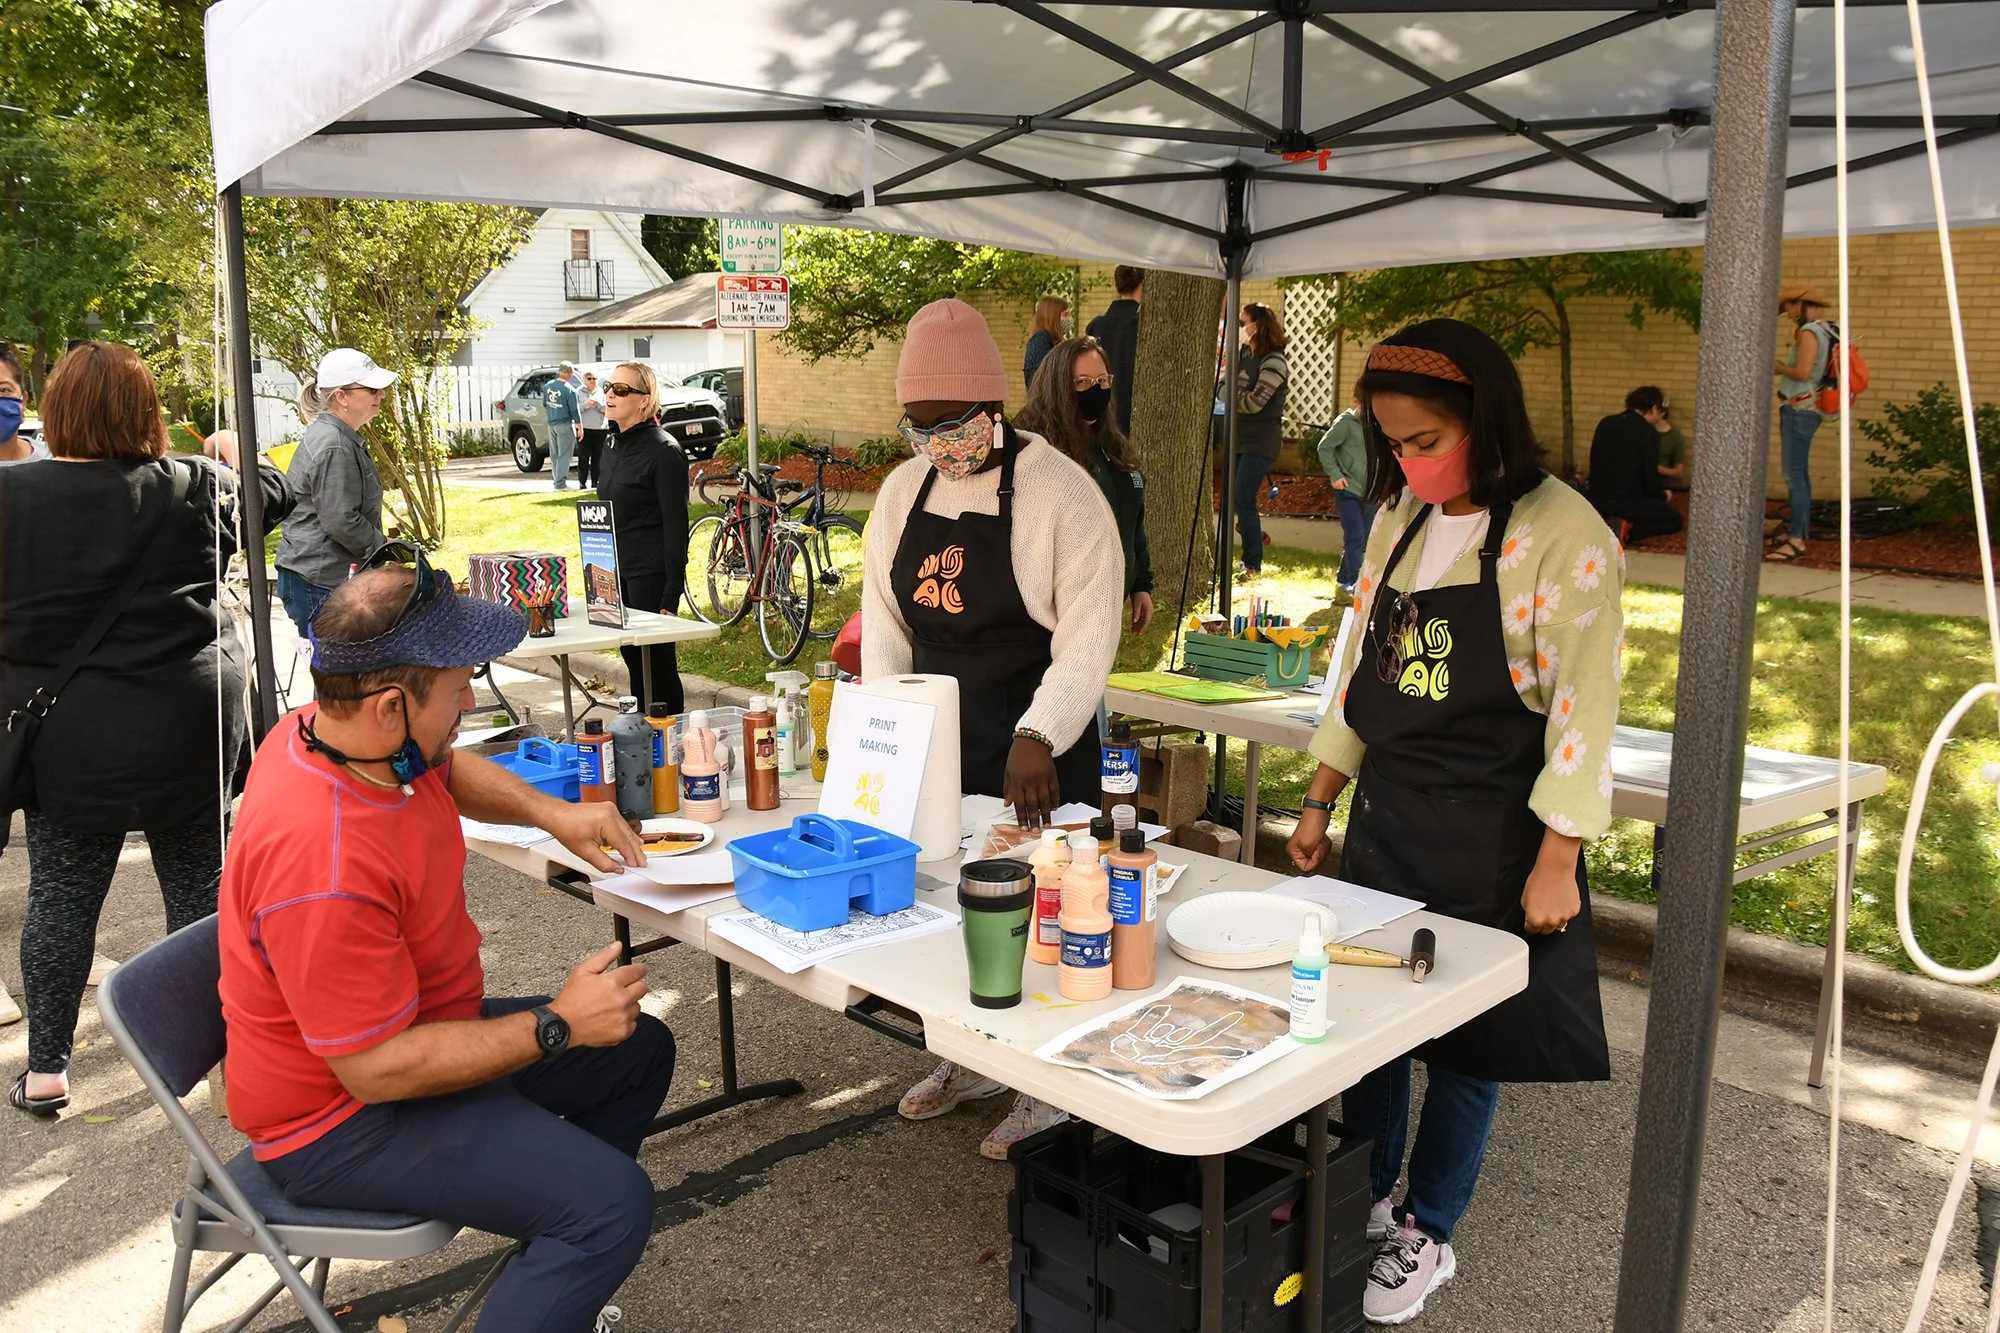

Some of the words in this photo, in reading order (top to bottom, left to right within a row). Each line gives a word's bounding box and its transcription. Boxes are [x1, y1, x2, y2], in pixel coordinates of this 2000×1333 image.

[720, 292, 748, 301] ALTERNATE
[750, 293, 762, 301] SIDE
[764, 293, 786, 302] PARKING
[721, 314, 739, 322] DURING
[740, 314, 755, 322] SNOW
[756, 314, 785, 323] EMERGENCY
[868, 717, 897, 732] PRINT
[858, 738, 898, 756] MAKING
[1102, 760, 1128, 770] VERSA
[1112, 868, 1134, 876] ORIGINAL
